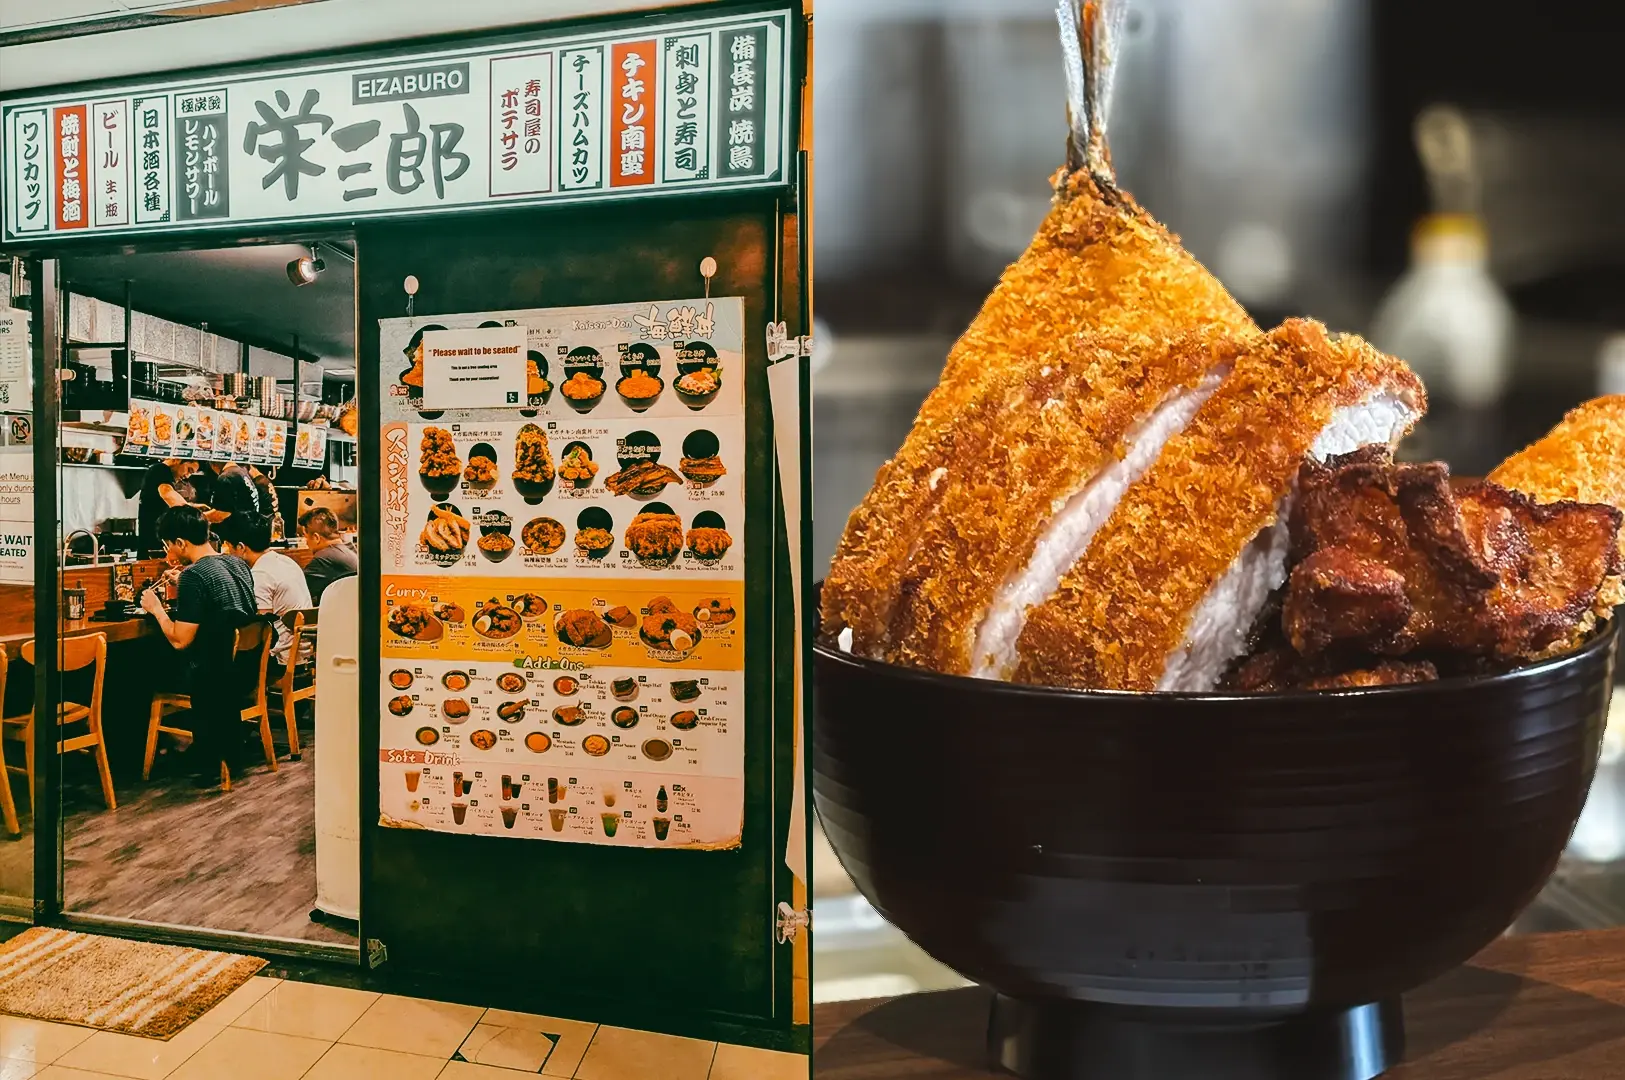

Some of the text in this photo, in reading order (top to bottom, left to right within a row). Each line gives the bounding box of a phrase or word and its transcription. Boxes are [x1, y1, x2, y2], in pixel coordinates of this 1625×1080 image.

[358, 69, 464, 99] EIZABURO
[524, 79, 541, 155] 寿司屋の
[573, 54, 591, 184] チーズハムカツ
[621, 52, 646, 177] チキン南蛮
[674, 44, 700, 171] 刺身と寿司
[728, 35, 755, 171] 備長炭 焼鳥
[59, 112, 82, 223] 焼酎と梅酒
[101, 109, 118, 169] ビール
[143, 109, 161, 213] 日本酒各種
[184, 119, 200, 215] レモンサワー
[202, 123, 218, 207] ハイボール
[243, 89, 471, 202] 栄三郎
[501, 88, 520, 171] ポテサラ
[22, 121, 42, 222] ワンカップ
[433, 349, 457, 357] Please
[458, 347, 473, 356] wait
[474, 347, 482, 355] to
[482, 347, 492, 355] be
[572, 316, 633, 331] Kaisen-Don
[1, 495, 21, 503] hours
[10, 473, 30, 481] Menu
[5, 535, 33, 546] WAIT
[385, 583, 429, 600] Curry
[522, 655, 585, 671] Add-Ons
[387, 747, 461, 766] Soft Drink
